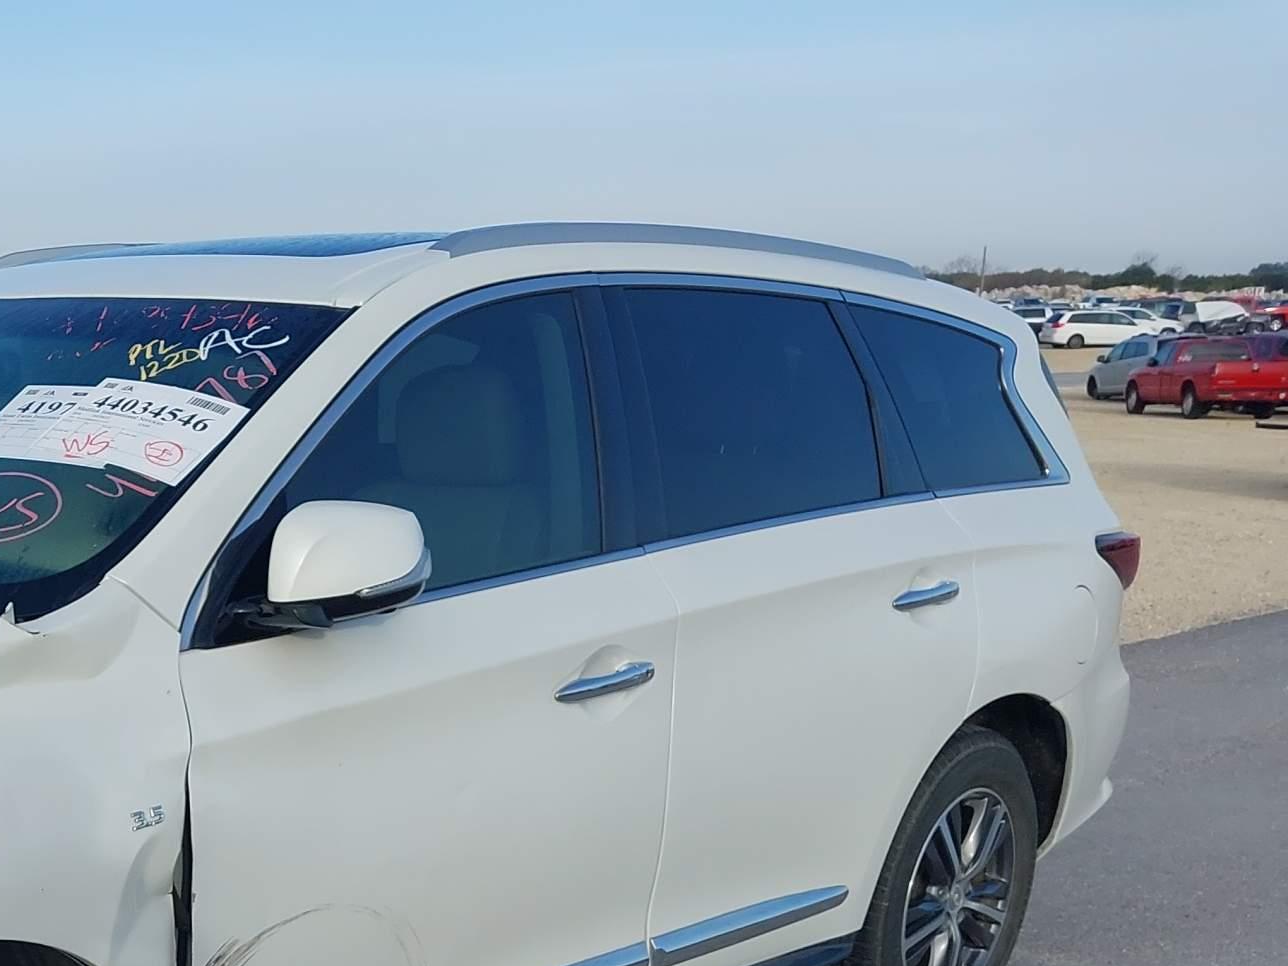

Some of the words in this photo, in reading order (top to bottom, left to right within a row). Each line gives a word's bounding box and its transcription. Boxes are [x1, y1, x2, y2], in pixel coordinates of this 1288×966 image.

[93, 395, 216, 432] 44034546
[62, 430, 110, 457] WS
[130, 805, 165, 832] 3.5
